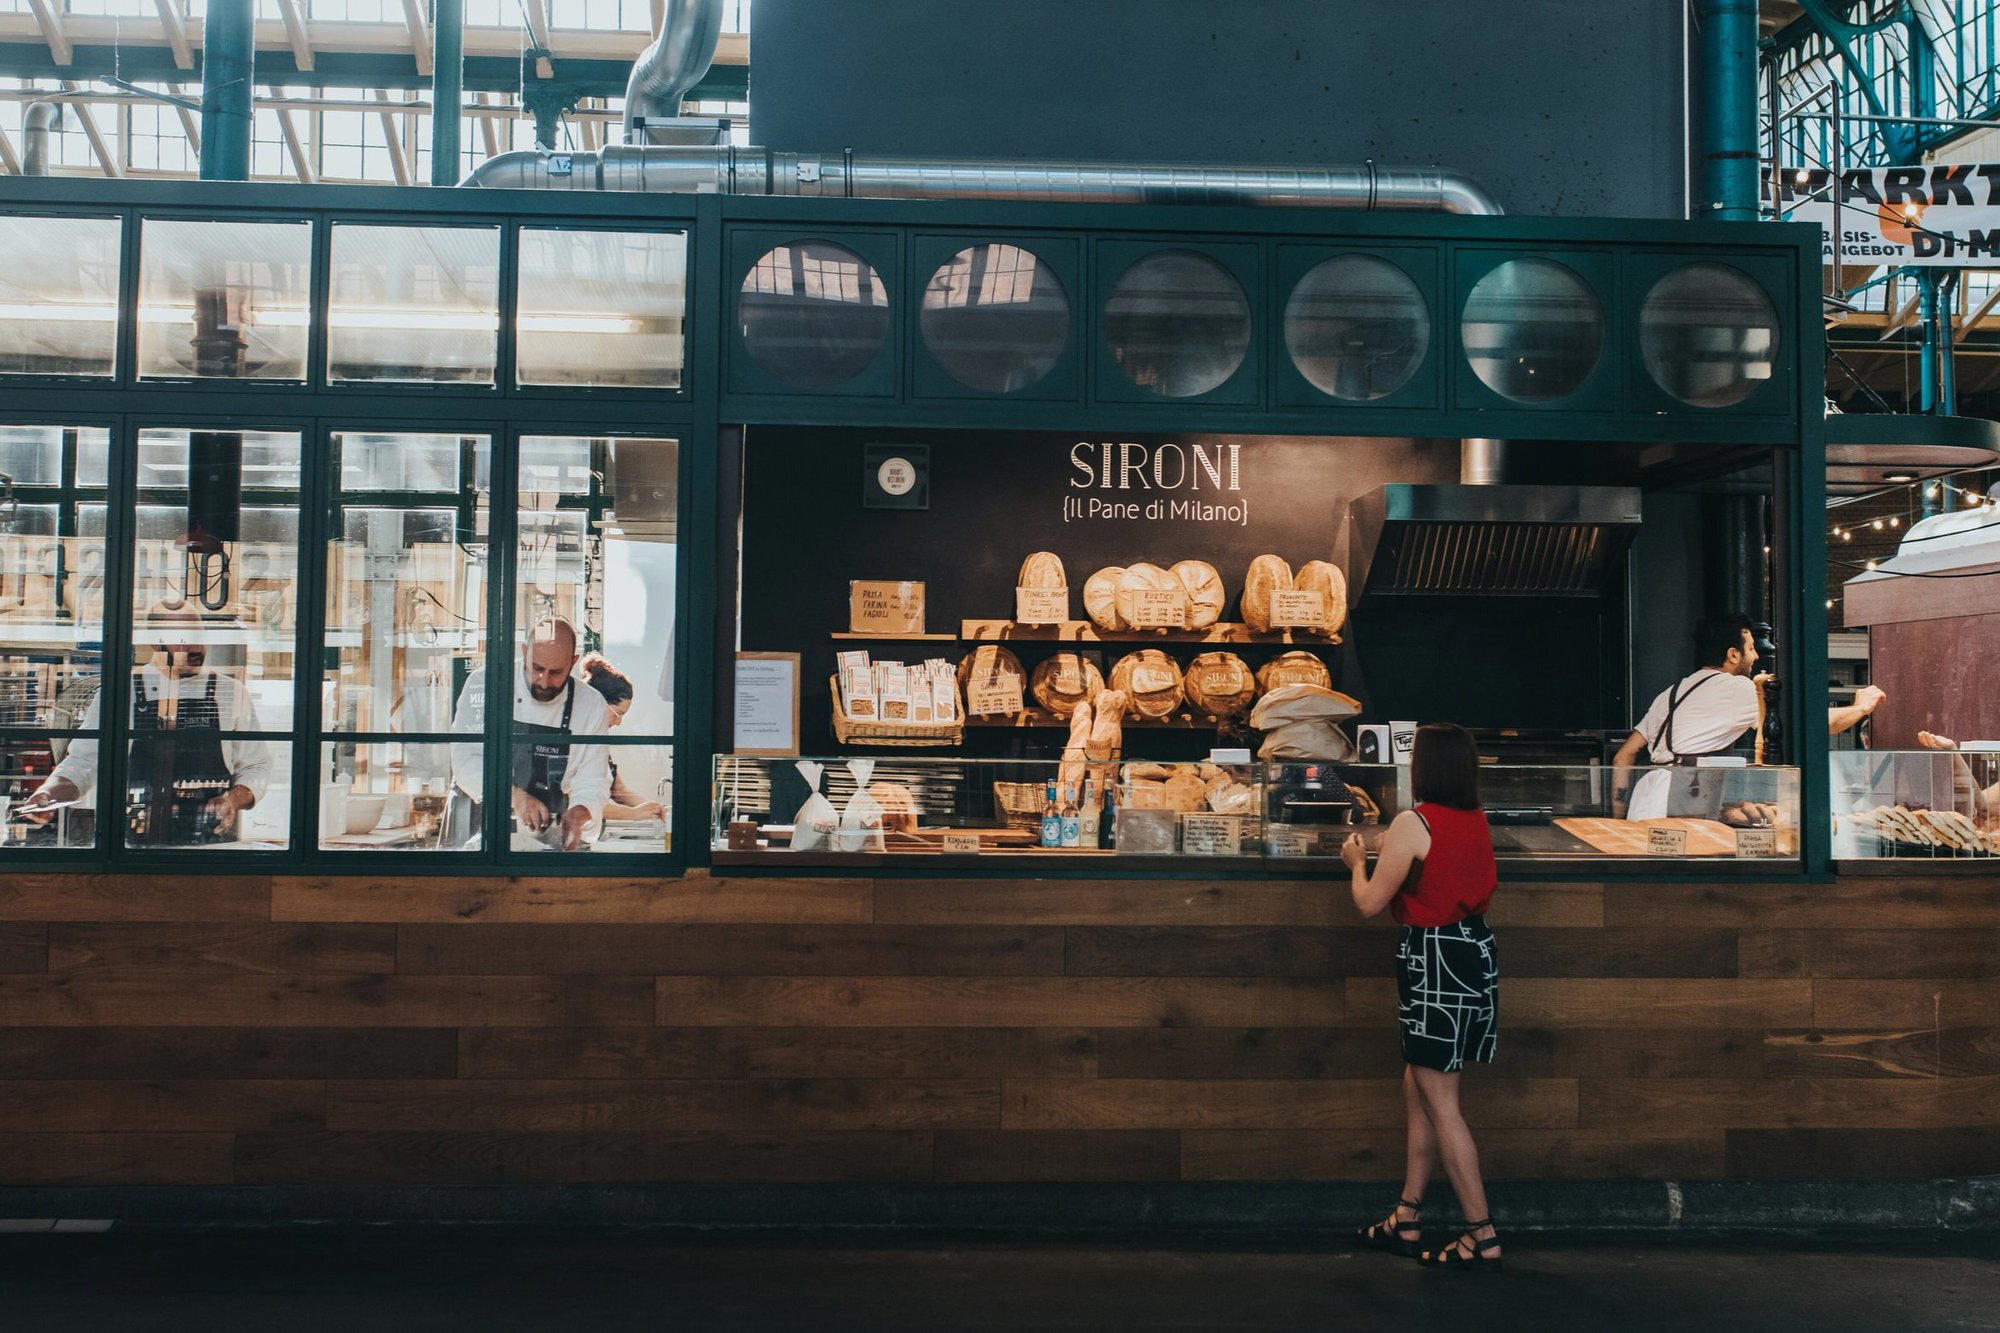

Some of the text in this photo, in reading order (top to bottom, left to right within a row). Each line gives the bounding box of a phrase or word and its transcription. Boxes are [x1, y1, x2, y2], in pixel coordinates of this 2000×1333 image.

[1822, 231, 1877, 242] BSIS-
[1070, 442, 1241, 490] SIRONI
[1089, 498, 1139, 519] Pane
[1145, 499, 1164, 520] di
[535, 745, 559, 755] SIRONI
